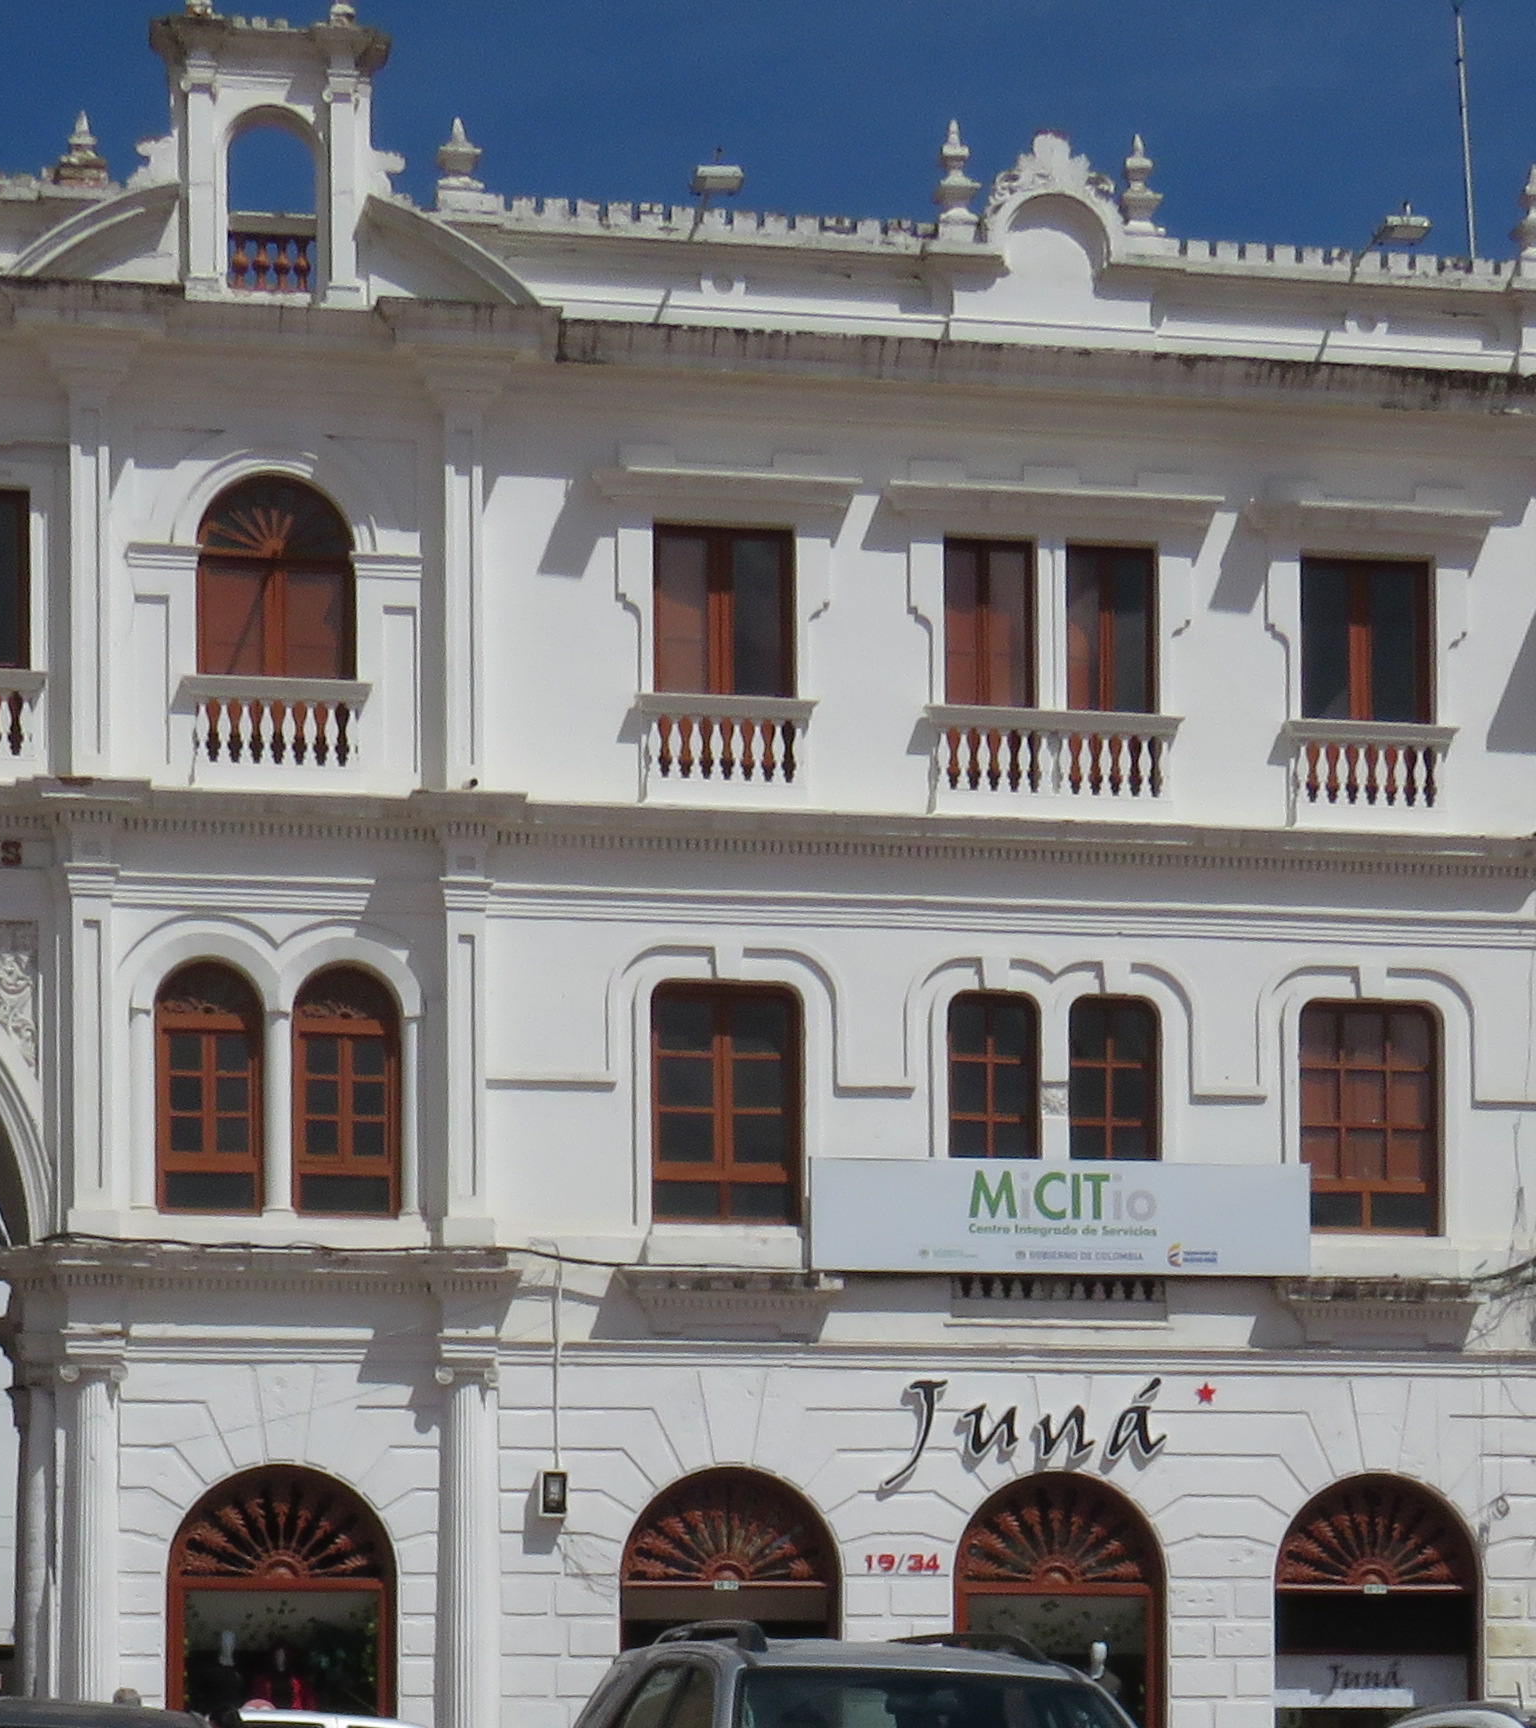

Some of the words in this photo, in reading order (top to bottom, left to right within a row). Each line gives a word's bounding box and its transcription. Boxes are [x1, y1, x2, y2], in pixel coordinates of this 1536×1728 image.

[968, 1222, 1010, 1235] Centro
[1014, 1223, 1078, 1238] Integrado
[1081, 1226, 1098, 1236] de
[1101, 1226, 1158, 1238] Servicios
[880, 1376, 1167, 1489] Juná
